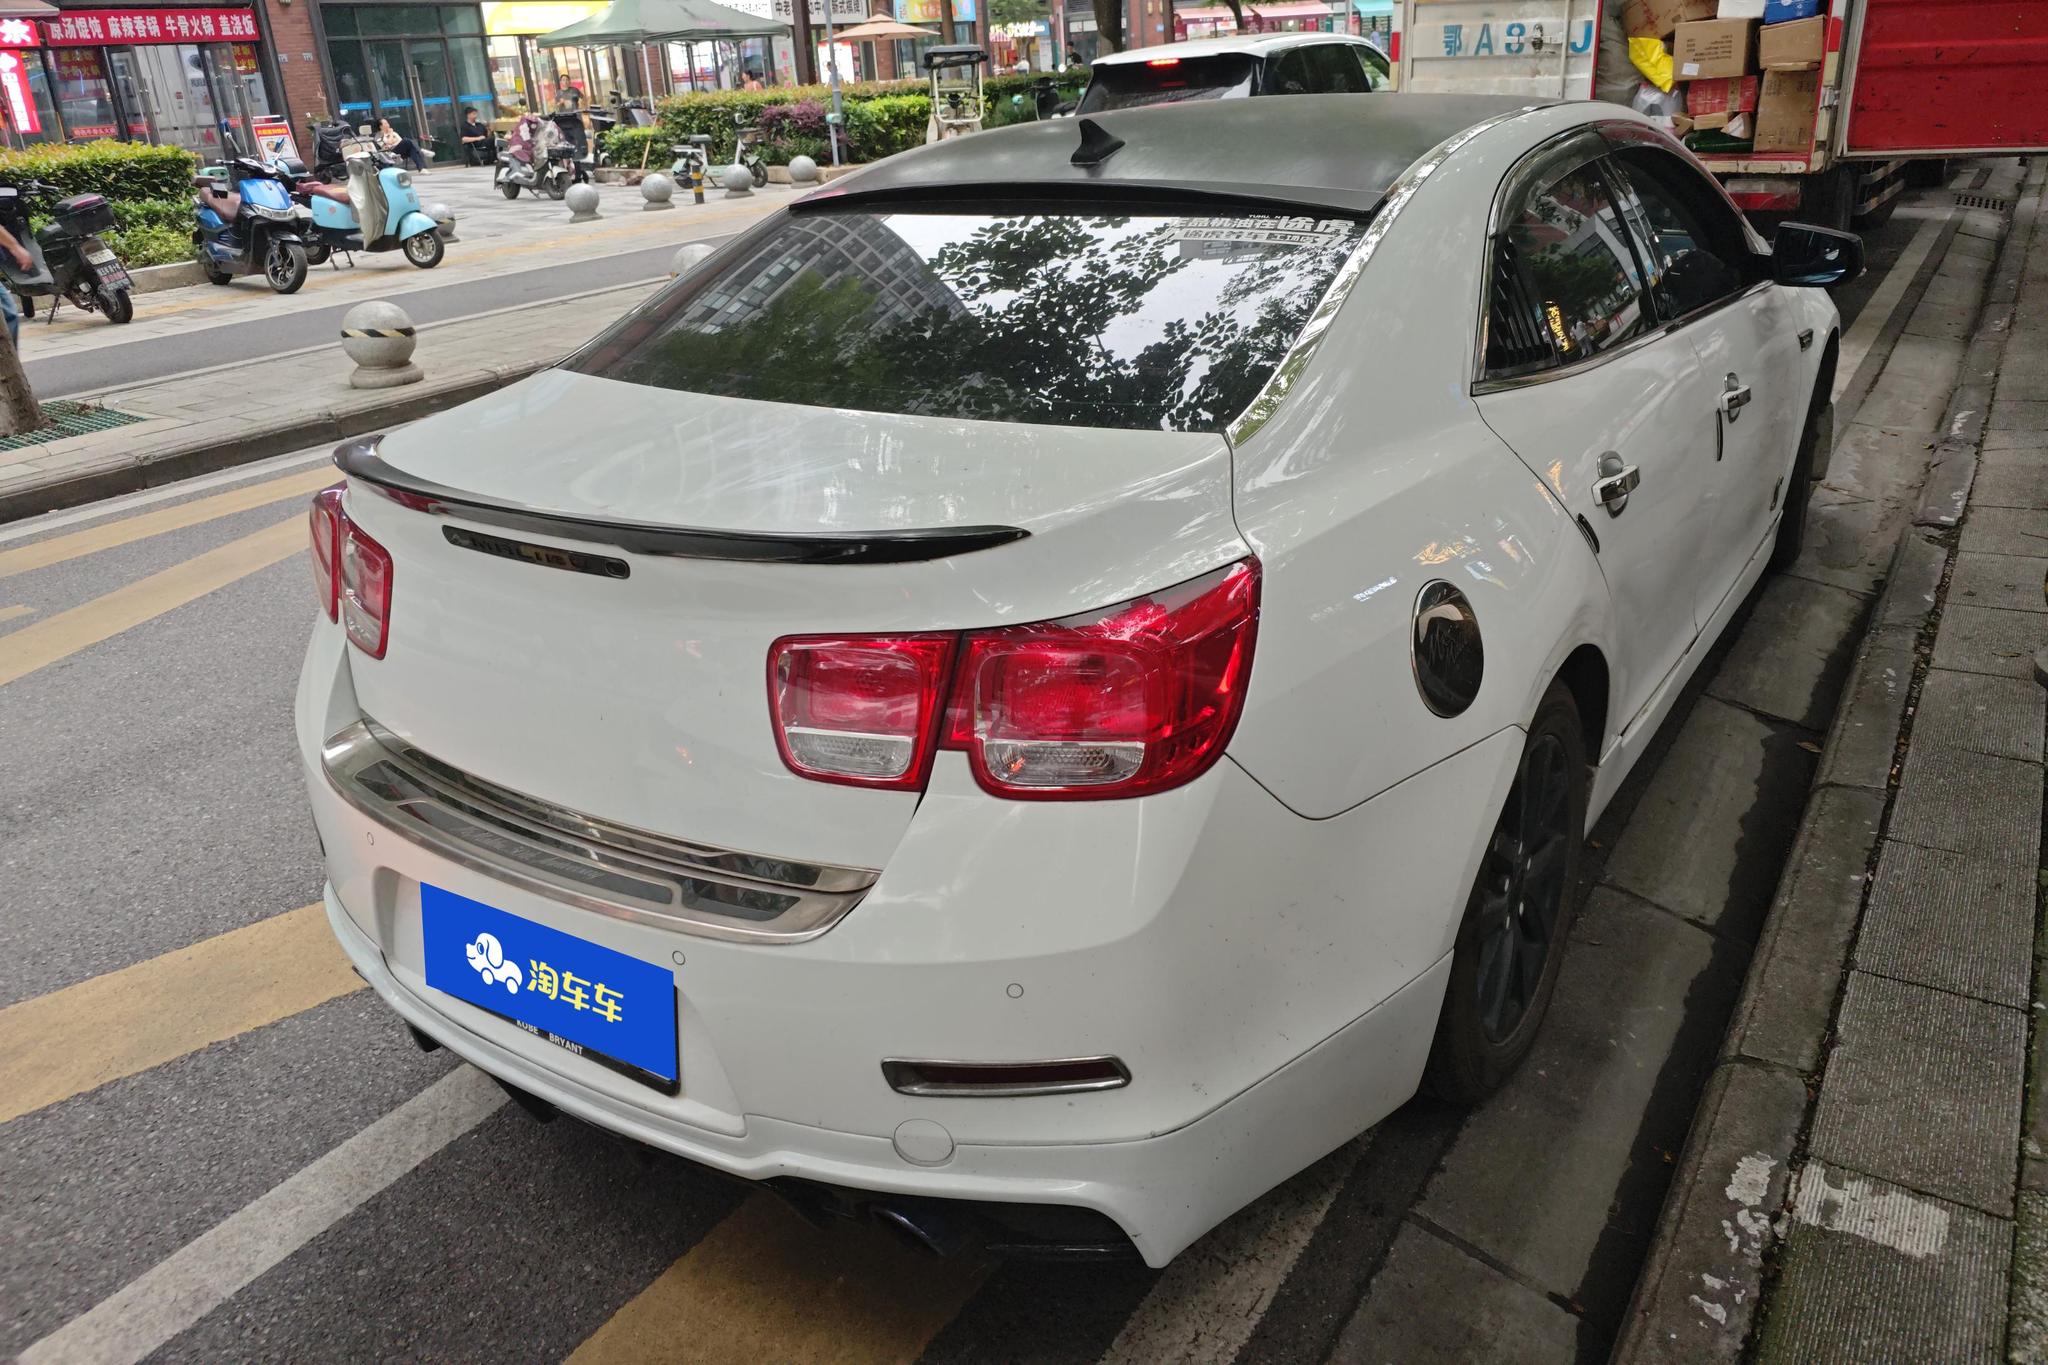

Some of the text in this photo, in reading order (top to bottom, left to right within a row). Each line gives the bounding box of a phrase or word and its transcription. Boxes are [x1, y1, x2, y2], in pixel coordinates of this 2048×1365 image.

[107, 15, 161, 38] 麻辣香锅
[165, 14, 215, 37] 牛骨火锅
[218, 14, 256, 36] 盖浇饭
[548, 1032, 583, 1055] BRYANT
